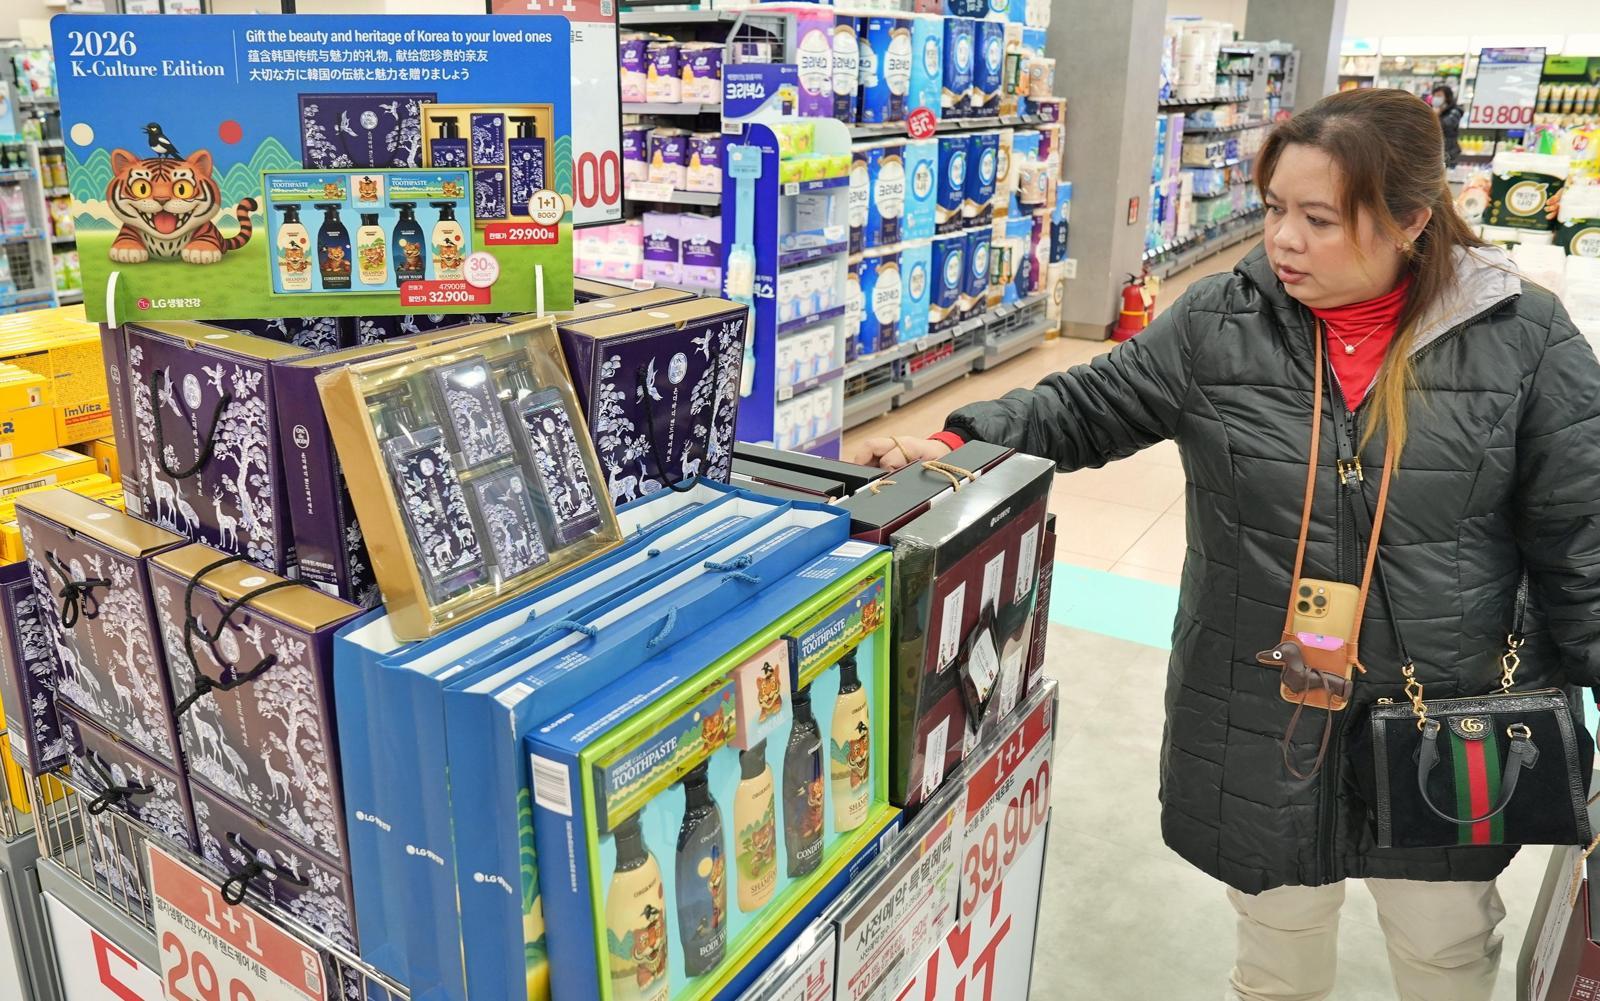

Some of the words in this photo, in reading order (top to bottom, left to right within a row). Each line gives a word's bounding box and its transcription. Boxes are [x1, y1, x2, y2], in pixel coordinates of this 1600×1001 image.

[68, 31, 137, 57] 2026
[245, 29, 266, 43] Gift
[267, 30, 287, 43] the
[289, 30, 329, 46] beauty
[330, 30, 352, 43] and
[355, 30, 402, 46] heritage
[404, 29, 415, 43] of
[417, 30, 450, 43] Korea
[451, 31, 463, 43] to
[465, 33, 490, 46] your
[492, 29, 523, 43] loved
[525, 33, 552, 43] ones
[396, 49, 489, 63] 献给您珍贵的亲友
[71, 61, 158, 77] K-Culture
[161, 60, 225, 77] Edition
[249, 67, 470, 81] 大切な方に韓国の伝統と魅力を贈りましょう
[1470, 105, 1535, 125] 19,800
[571, 149, 621, 208] 00
[537, 197, 557, 209] 1+1
[470, 257, 496, 271] 30%
[801, 618, 846, 658] TOOTHPASTE
[612, 736, 679, 790] TOOTHPASTE
[994, 726, 1025, 785] 1+1
[962, 759, 1050, 918] 39,900
[856, 882, 907, 952] 사전예약
[908, 830, 954, 893] 특별혜택
[202, 887, 264, 958] 1+1
[251, 961, 268, 982] 세트
